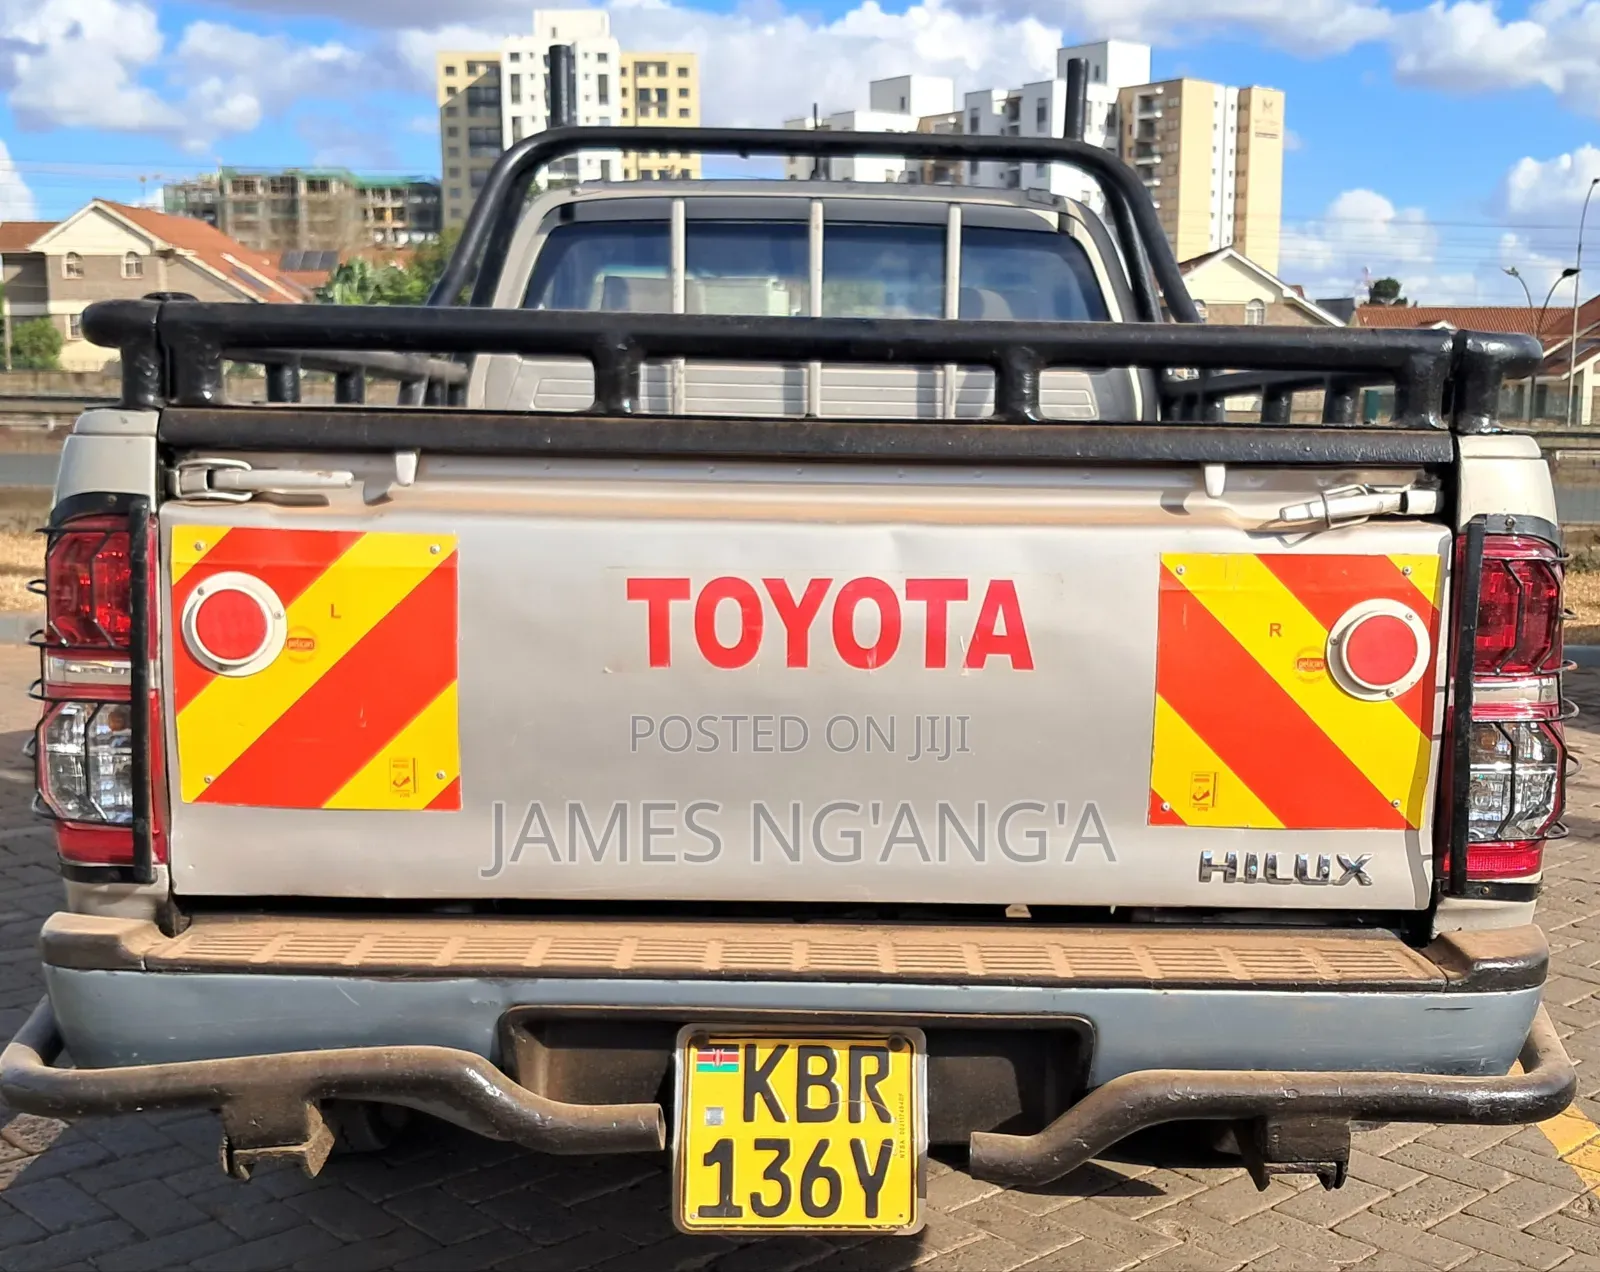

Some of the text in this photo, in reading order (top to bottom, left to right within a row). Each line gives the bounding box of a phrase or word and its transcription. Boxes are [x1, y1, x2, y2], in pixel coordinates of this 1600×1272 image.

[330, 603, 341, 619] L
[627, 576, 1036, 671] TOYOTA
[1269, 623, 1282, 637] R
[1198, 850, 1372, 886] HILUX
[743, 1044, 895, 1123] KBR
[697, 1138, 894, 1218] 136Y
